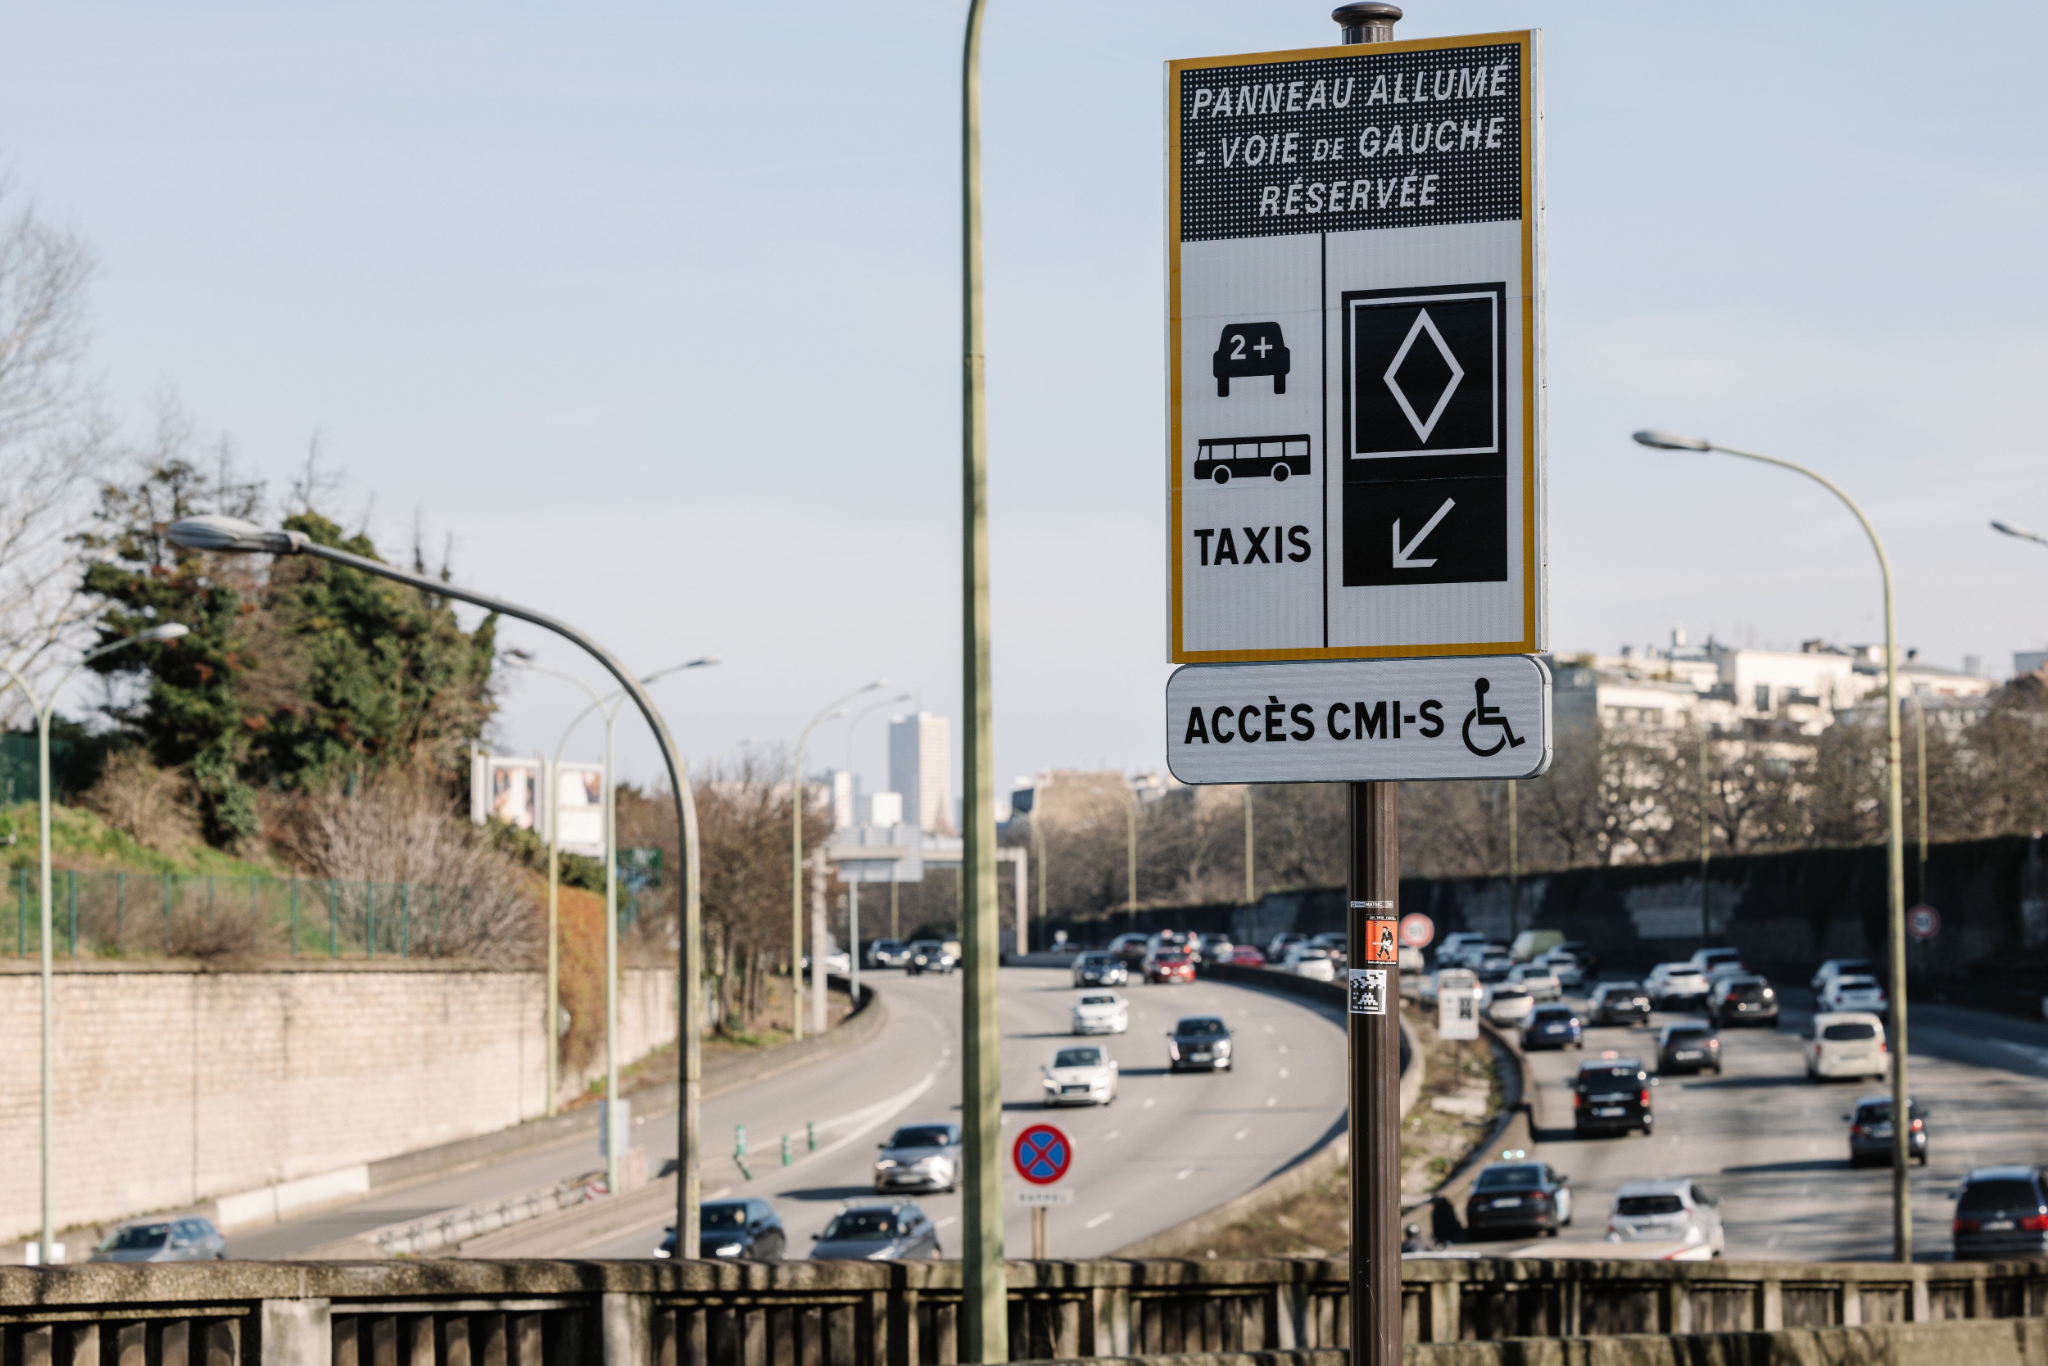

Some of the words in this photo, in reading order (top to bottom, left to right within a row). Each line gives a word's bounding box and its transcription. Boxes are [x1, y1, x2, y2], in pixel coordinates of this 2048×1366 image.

[1192, 78, 1355, 119] PANNEAU
[1367, 58, 1508, 106] ALLUMÉ
[1221, 132, 1300, 168] VOIE
[1312, 137, 1345, 162] DE
[1359, 117, 1506, 158] GAUCHE
[1259, 169, 1440, 217] RÉSERVÉE
[1194, 525, 1312, 566] TAXIS
[1184, 695, 1315, 744] ACCÈS
[1327, 699, 1445, 741] CMI-S
